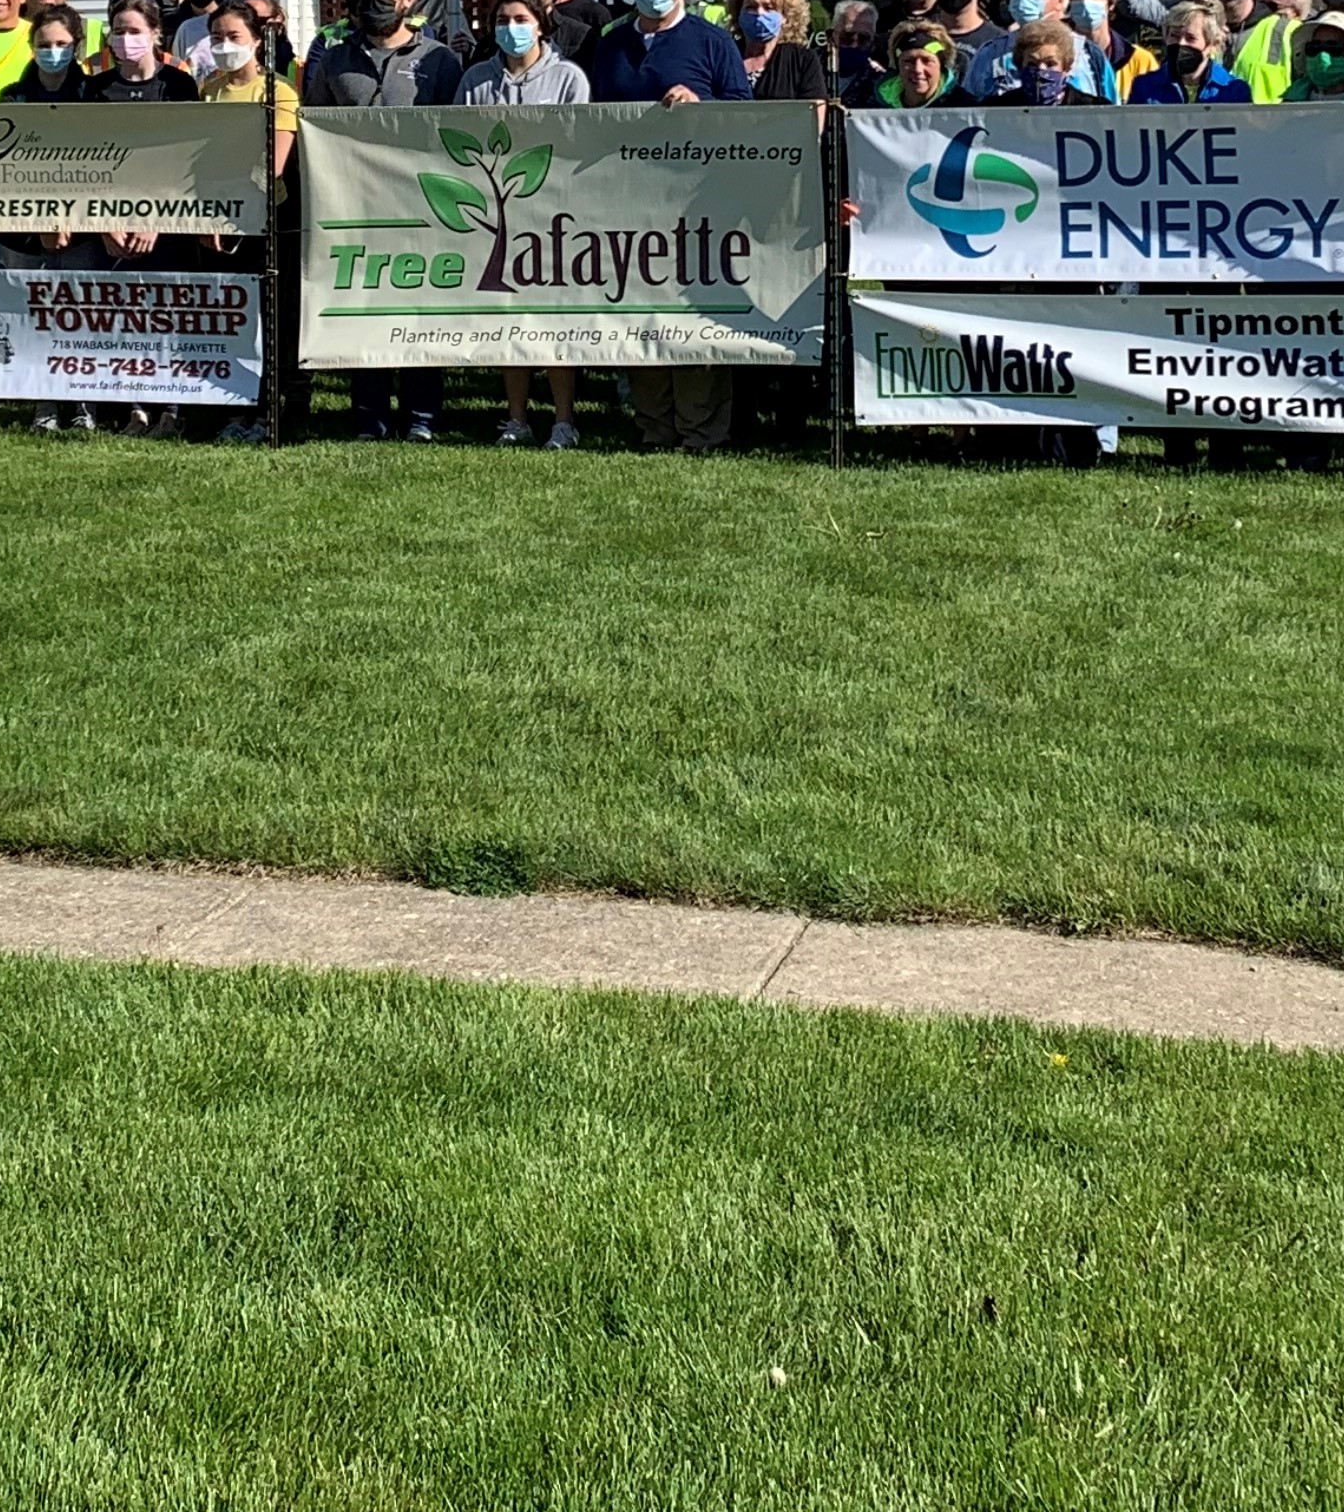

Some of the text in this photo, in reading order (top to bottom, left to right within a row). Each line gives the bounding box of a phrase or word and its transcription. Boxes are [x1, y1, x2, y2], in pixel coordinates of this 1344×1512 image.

[24, 130, 42, 143] the
[619, 140, 803, 166] treelafayette.org
[1055, 127, 1239, 188] DUKE
[1, 163, 113, 184] Foundation
[87, 199, 244, 219] ENDOWMENT
[1060, 198, 1340, 260] ENERGY
[330, 245, 466, 290] Tree
[26, 281, 248, 310] FAIRFIELD
[29, 307, 248, 336] TOWNSHIP
[1165, 308, 1344, 343] Tipmont
[52, 340, 71, 350] 718
[72, 340, 118, 351] WABASH
[120, 341, 161, 352] AVENUE
[170, 343, 227, 354] LAFAYETTE
[390, 326, 806, 347] Planting and Promoting a Healthy Community
[47, 356, 232, 379] 765-742-7476
[876, 332, 1078, 399] EnviroWatts
[69, 381, 202, 394] www.fairfieldtownship.us
